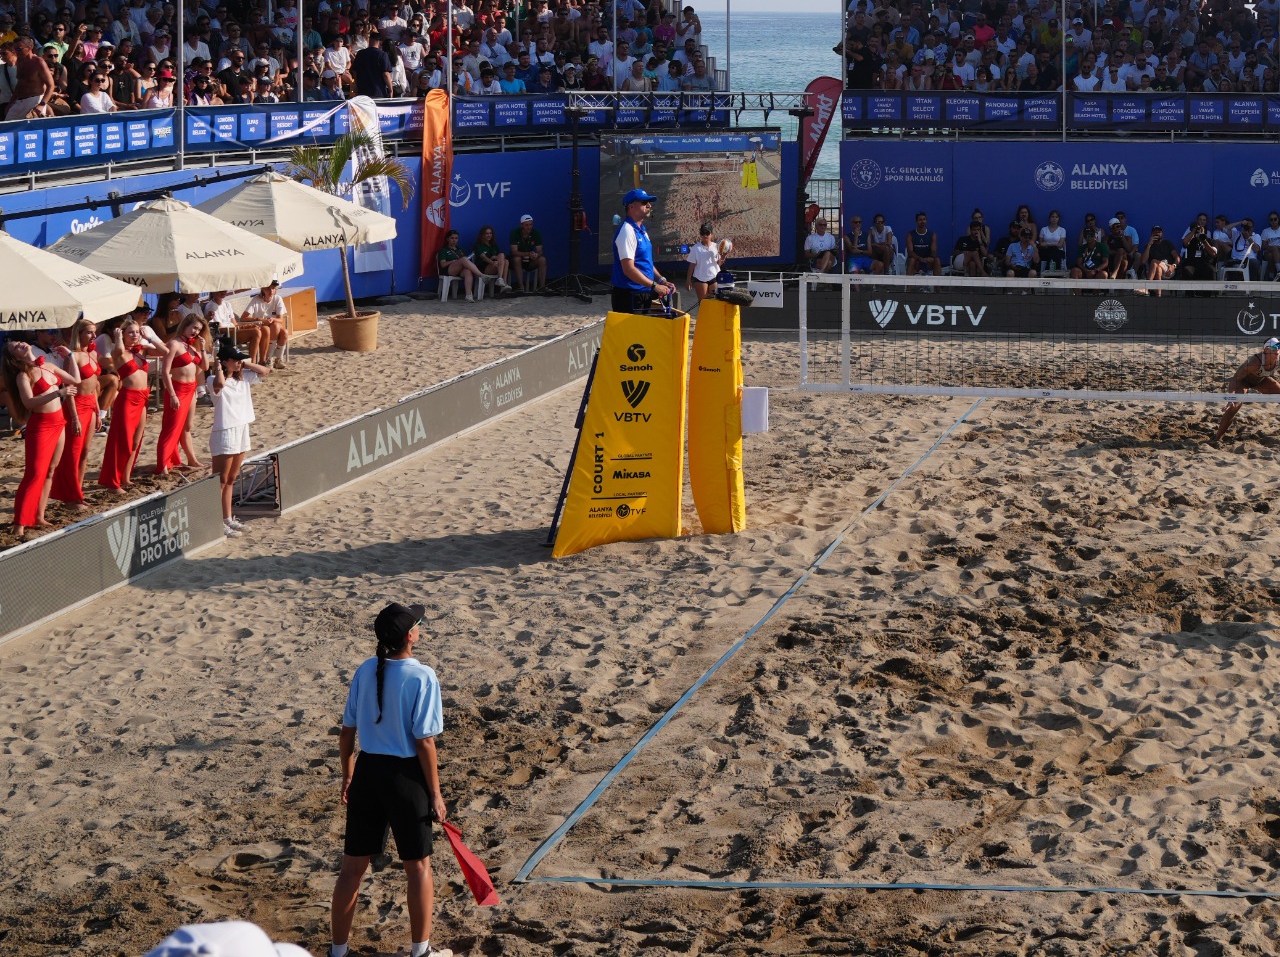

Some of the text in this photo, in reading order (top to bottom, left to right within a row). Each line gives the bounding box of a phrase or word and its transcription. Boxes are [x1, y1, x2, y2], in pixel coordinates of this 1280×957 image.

[431, 144, 443, 194] ALANYA
[900, 166, 932, 175] GENÇLİK
[1071, 163, 1127, 176] ALANYA
[905, 174, 944, 182] BAKANLIĞI
[1071, 178, 1128, 190] BELEDİYESİ
[475, 182, 511, 200] TVF
[230, 219, 265, 227] ANYA
[303, 233, 345, 247] ALANYA
[186, 248, 245, 261] ALANYA
[117, 277, 148, 287] NYA
[758, 291, 782, 299] VBTV
[0, 310, 47, 324] LANYA
[903, 304, 987, 326] VBTV
[619, 364, 653, 372] Senoh
[495, 366, 521, 390] ALANYA
[496, 386, 523, 407] BELEDİYESİ
[614, 412, 652, 423] VBTV
[347, 407, 427, 473] ALANYA
[593, 445, 604, 494] COURT
[138, 505, 169, 522] VOLLEYBALL
[139, 506, 189, 548] BEACH
[140, 531, 190, 566] PRO TOUR
